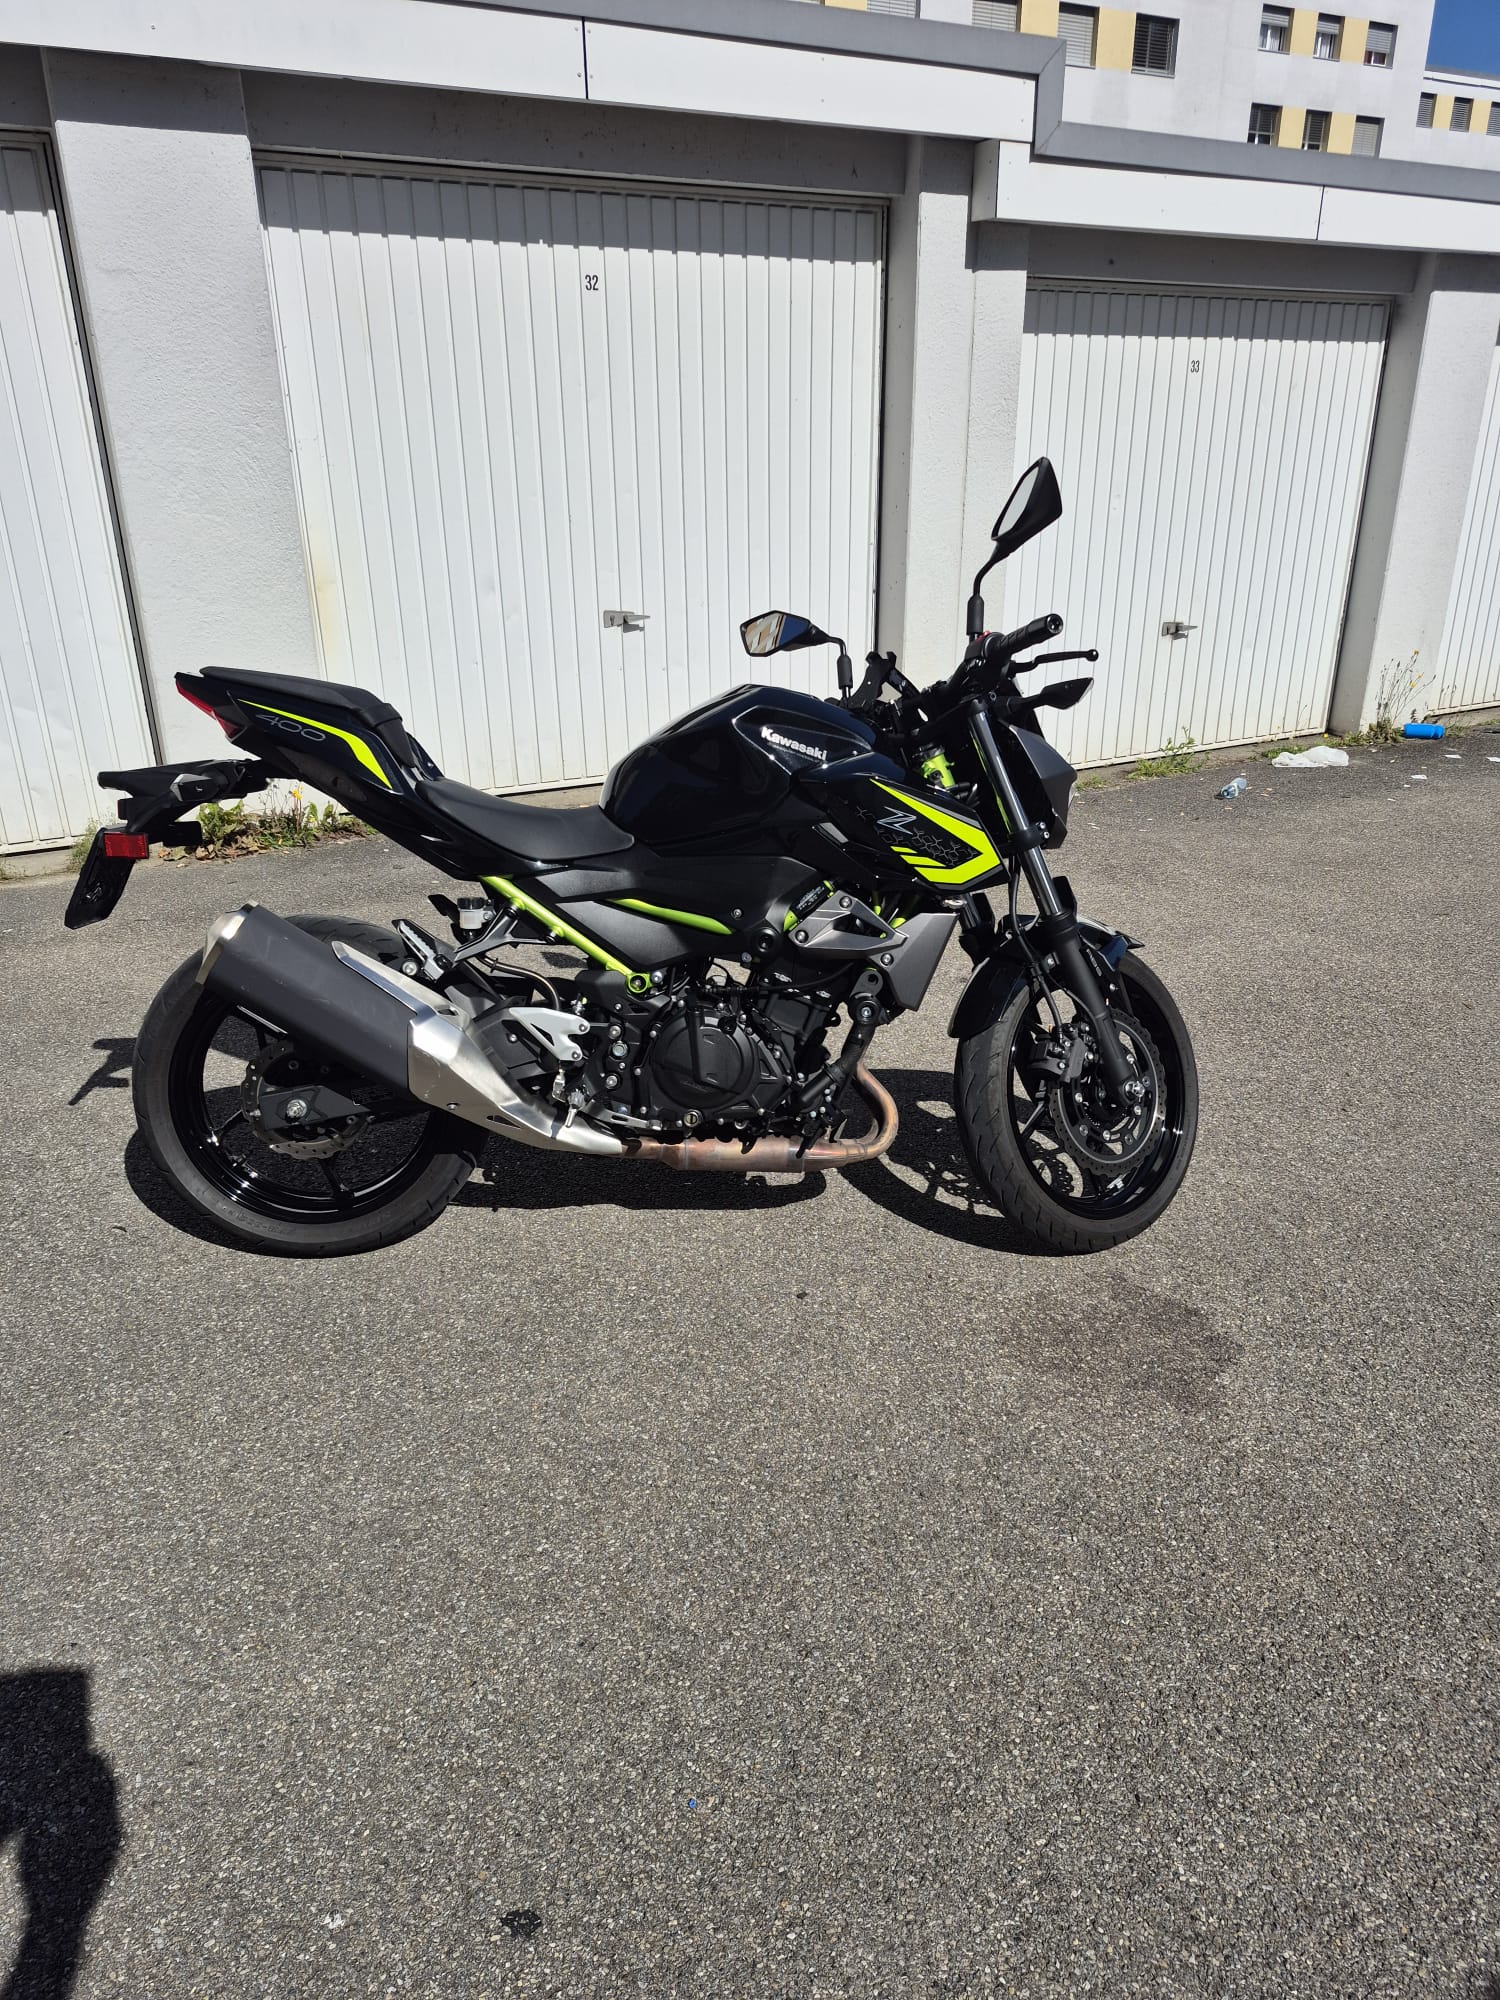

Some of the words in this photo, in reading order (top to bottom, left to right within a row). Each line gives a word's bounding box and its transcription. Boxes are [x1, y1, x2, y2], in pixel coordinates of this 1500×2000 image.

[585, 274, 599, 291] 32
[1190, 360, 1200, 373] 33
[255, 713, 327, 742] 400
[760, 725, 828, 761] Kawasaki
